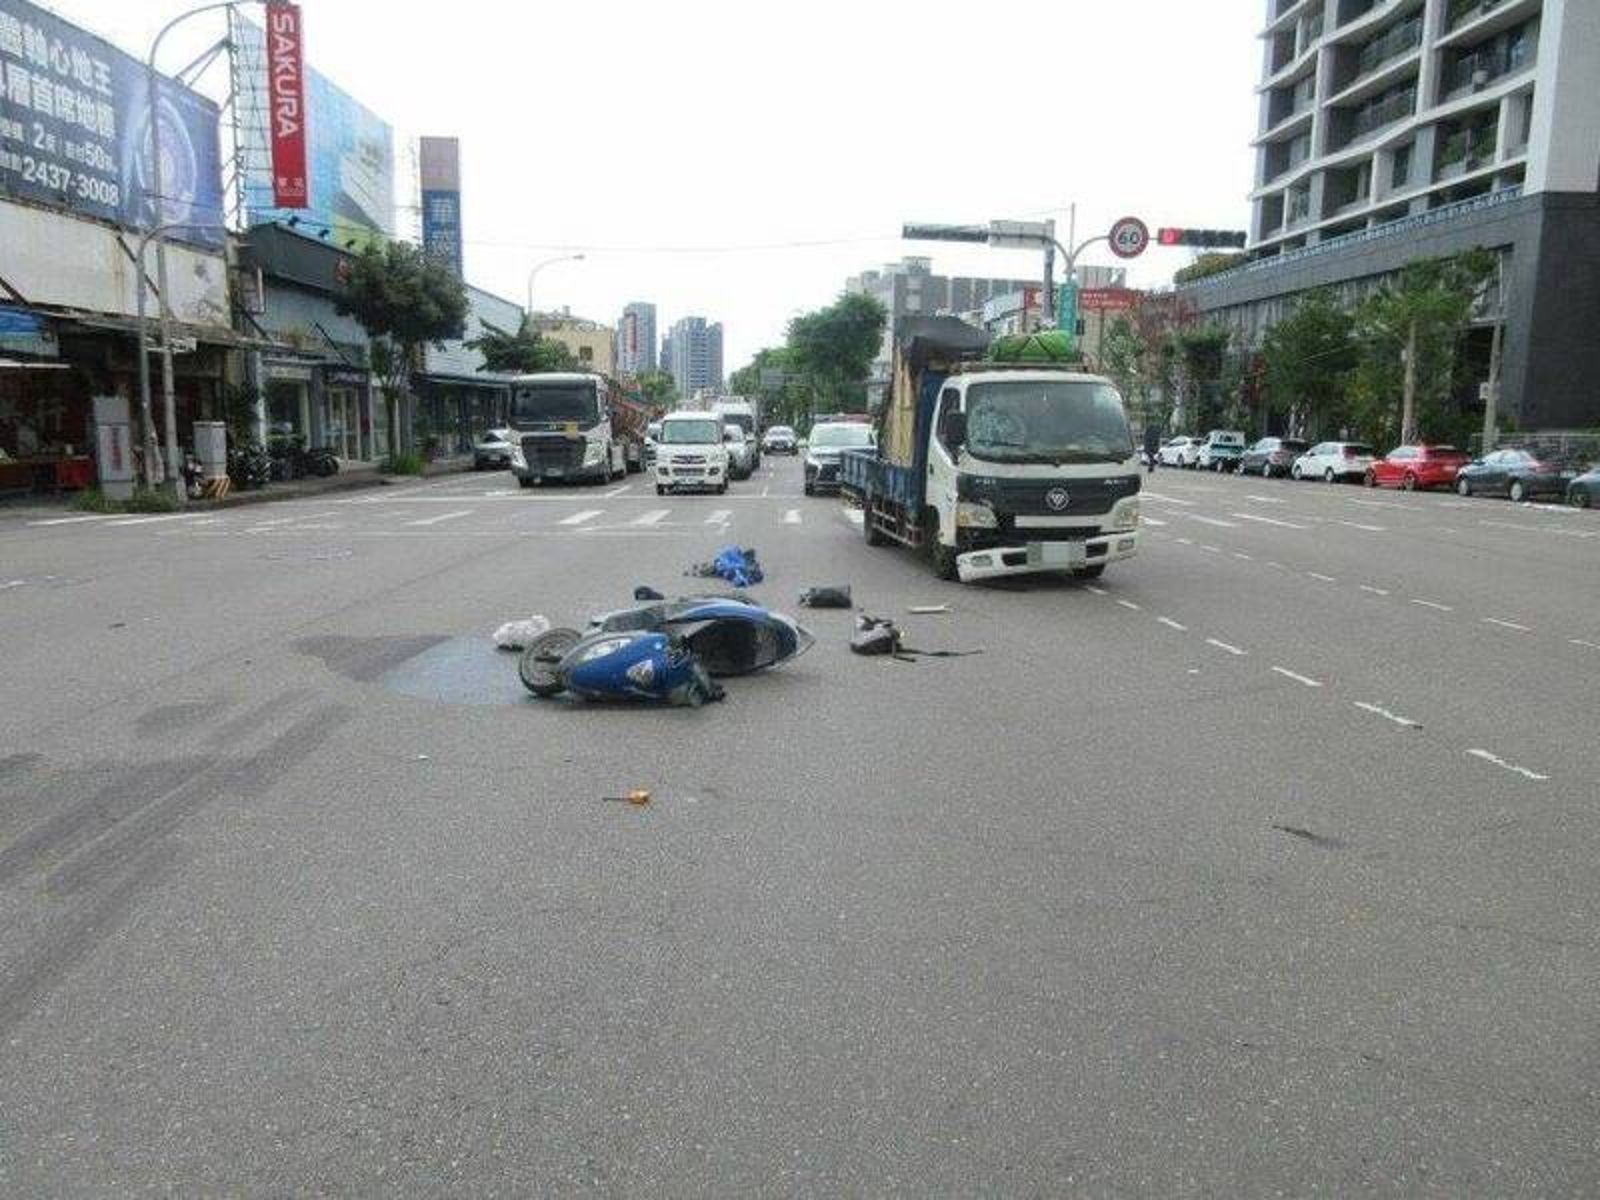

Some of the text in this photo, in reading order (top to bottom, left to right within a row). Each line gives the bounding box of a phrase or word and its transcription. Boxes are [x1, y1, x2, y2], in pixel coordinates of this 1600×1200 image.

[273, 13, 300, 138] SAKURA
[22, 155, 119, 207] 2437-3008
[1118, 231, 1141, 245] 60
